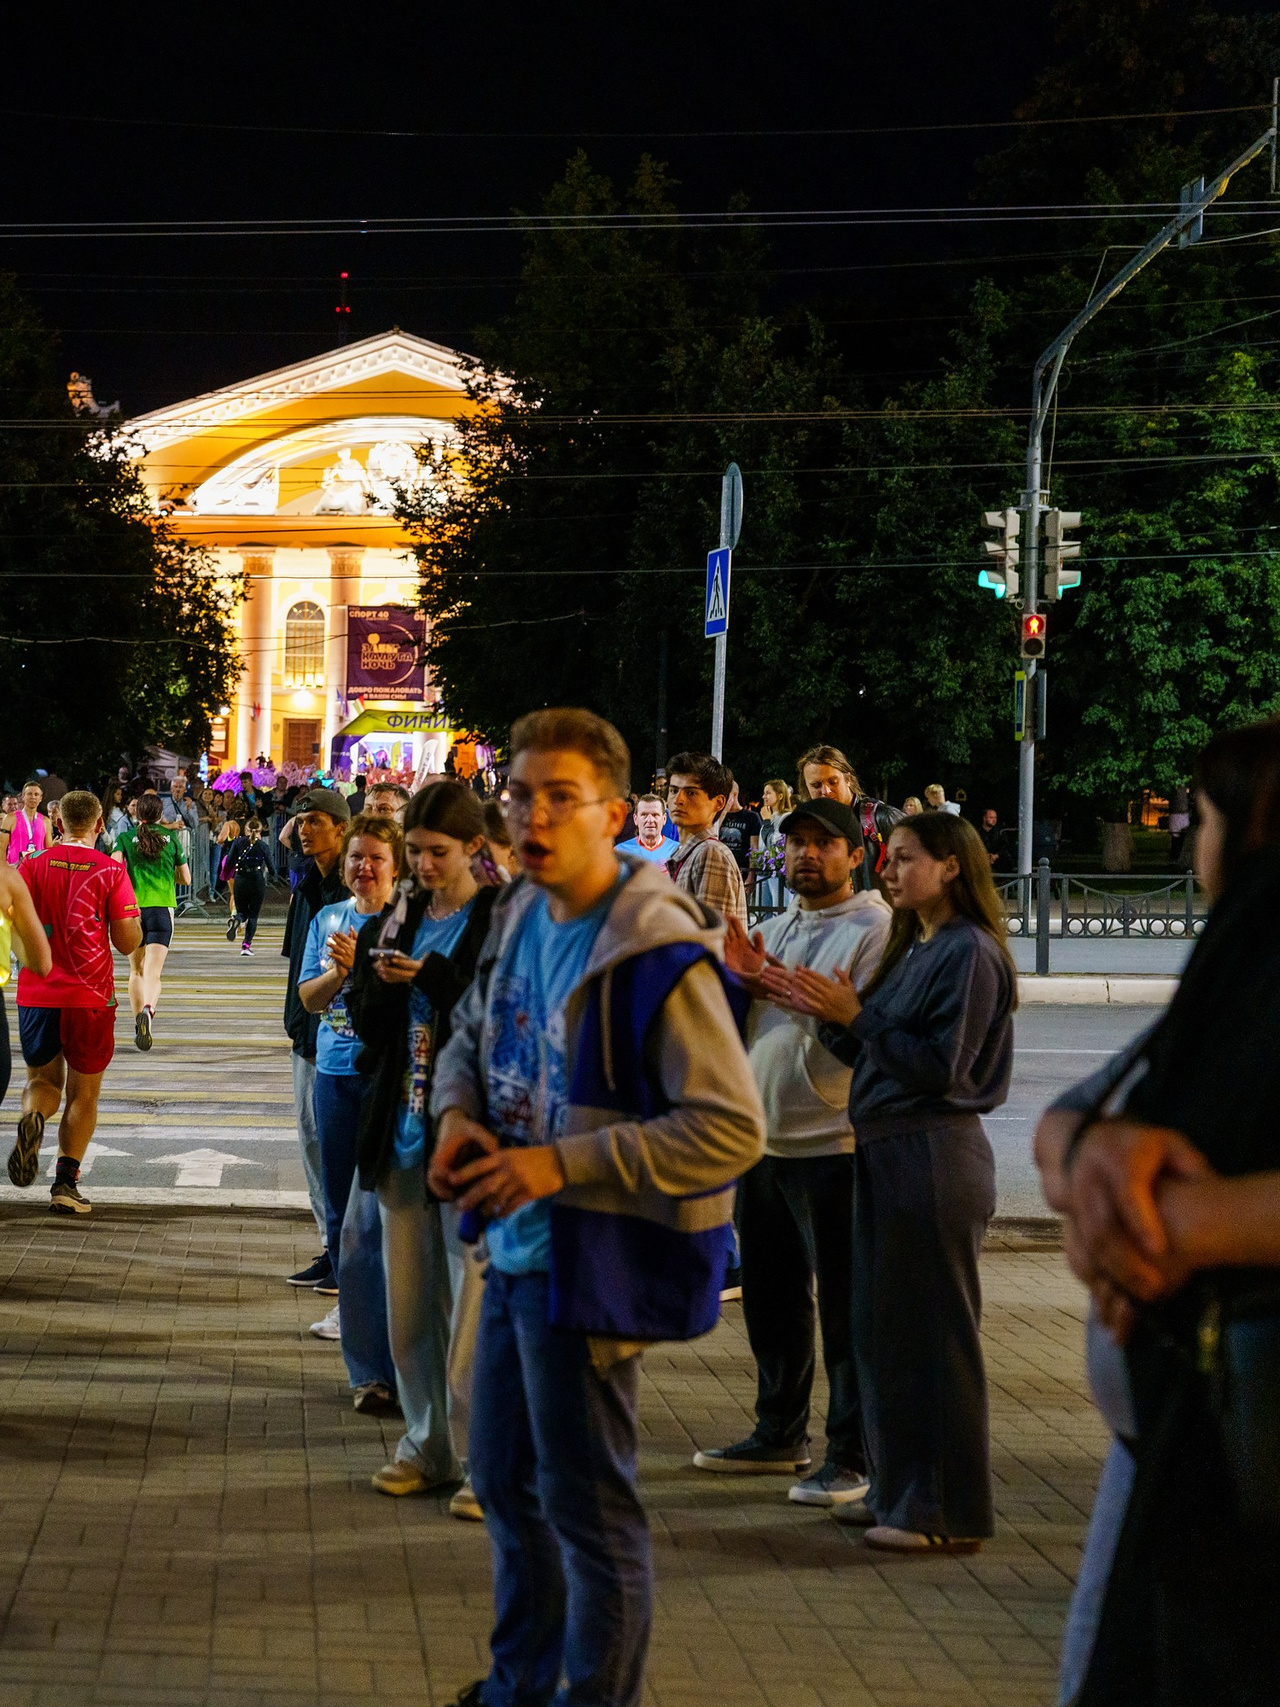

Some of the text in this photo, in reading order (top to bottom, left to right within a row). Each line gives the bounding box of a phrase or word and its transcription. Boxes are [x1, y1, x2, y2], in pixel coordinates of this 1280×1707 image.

[348, 610, 389, 618] СПОРТ 40
[361, 652, 413, 662] КАЛУГА
[361, 660, 396, 670] НОЧЬ
[348, 686, 423, 694] ДОБРО ПОЖАЛОВАТЬ
